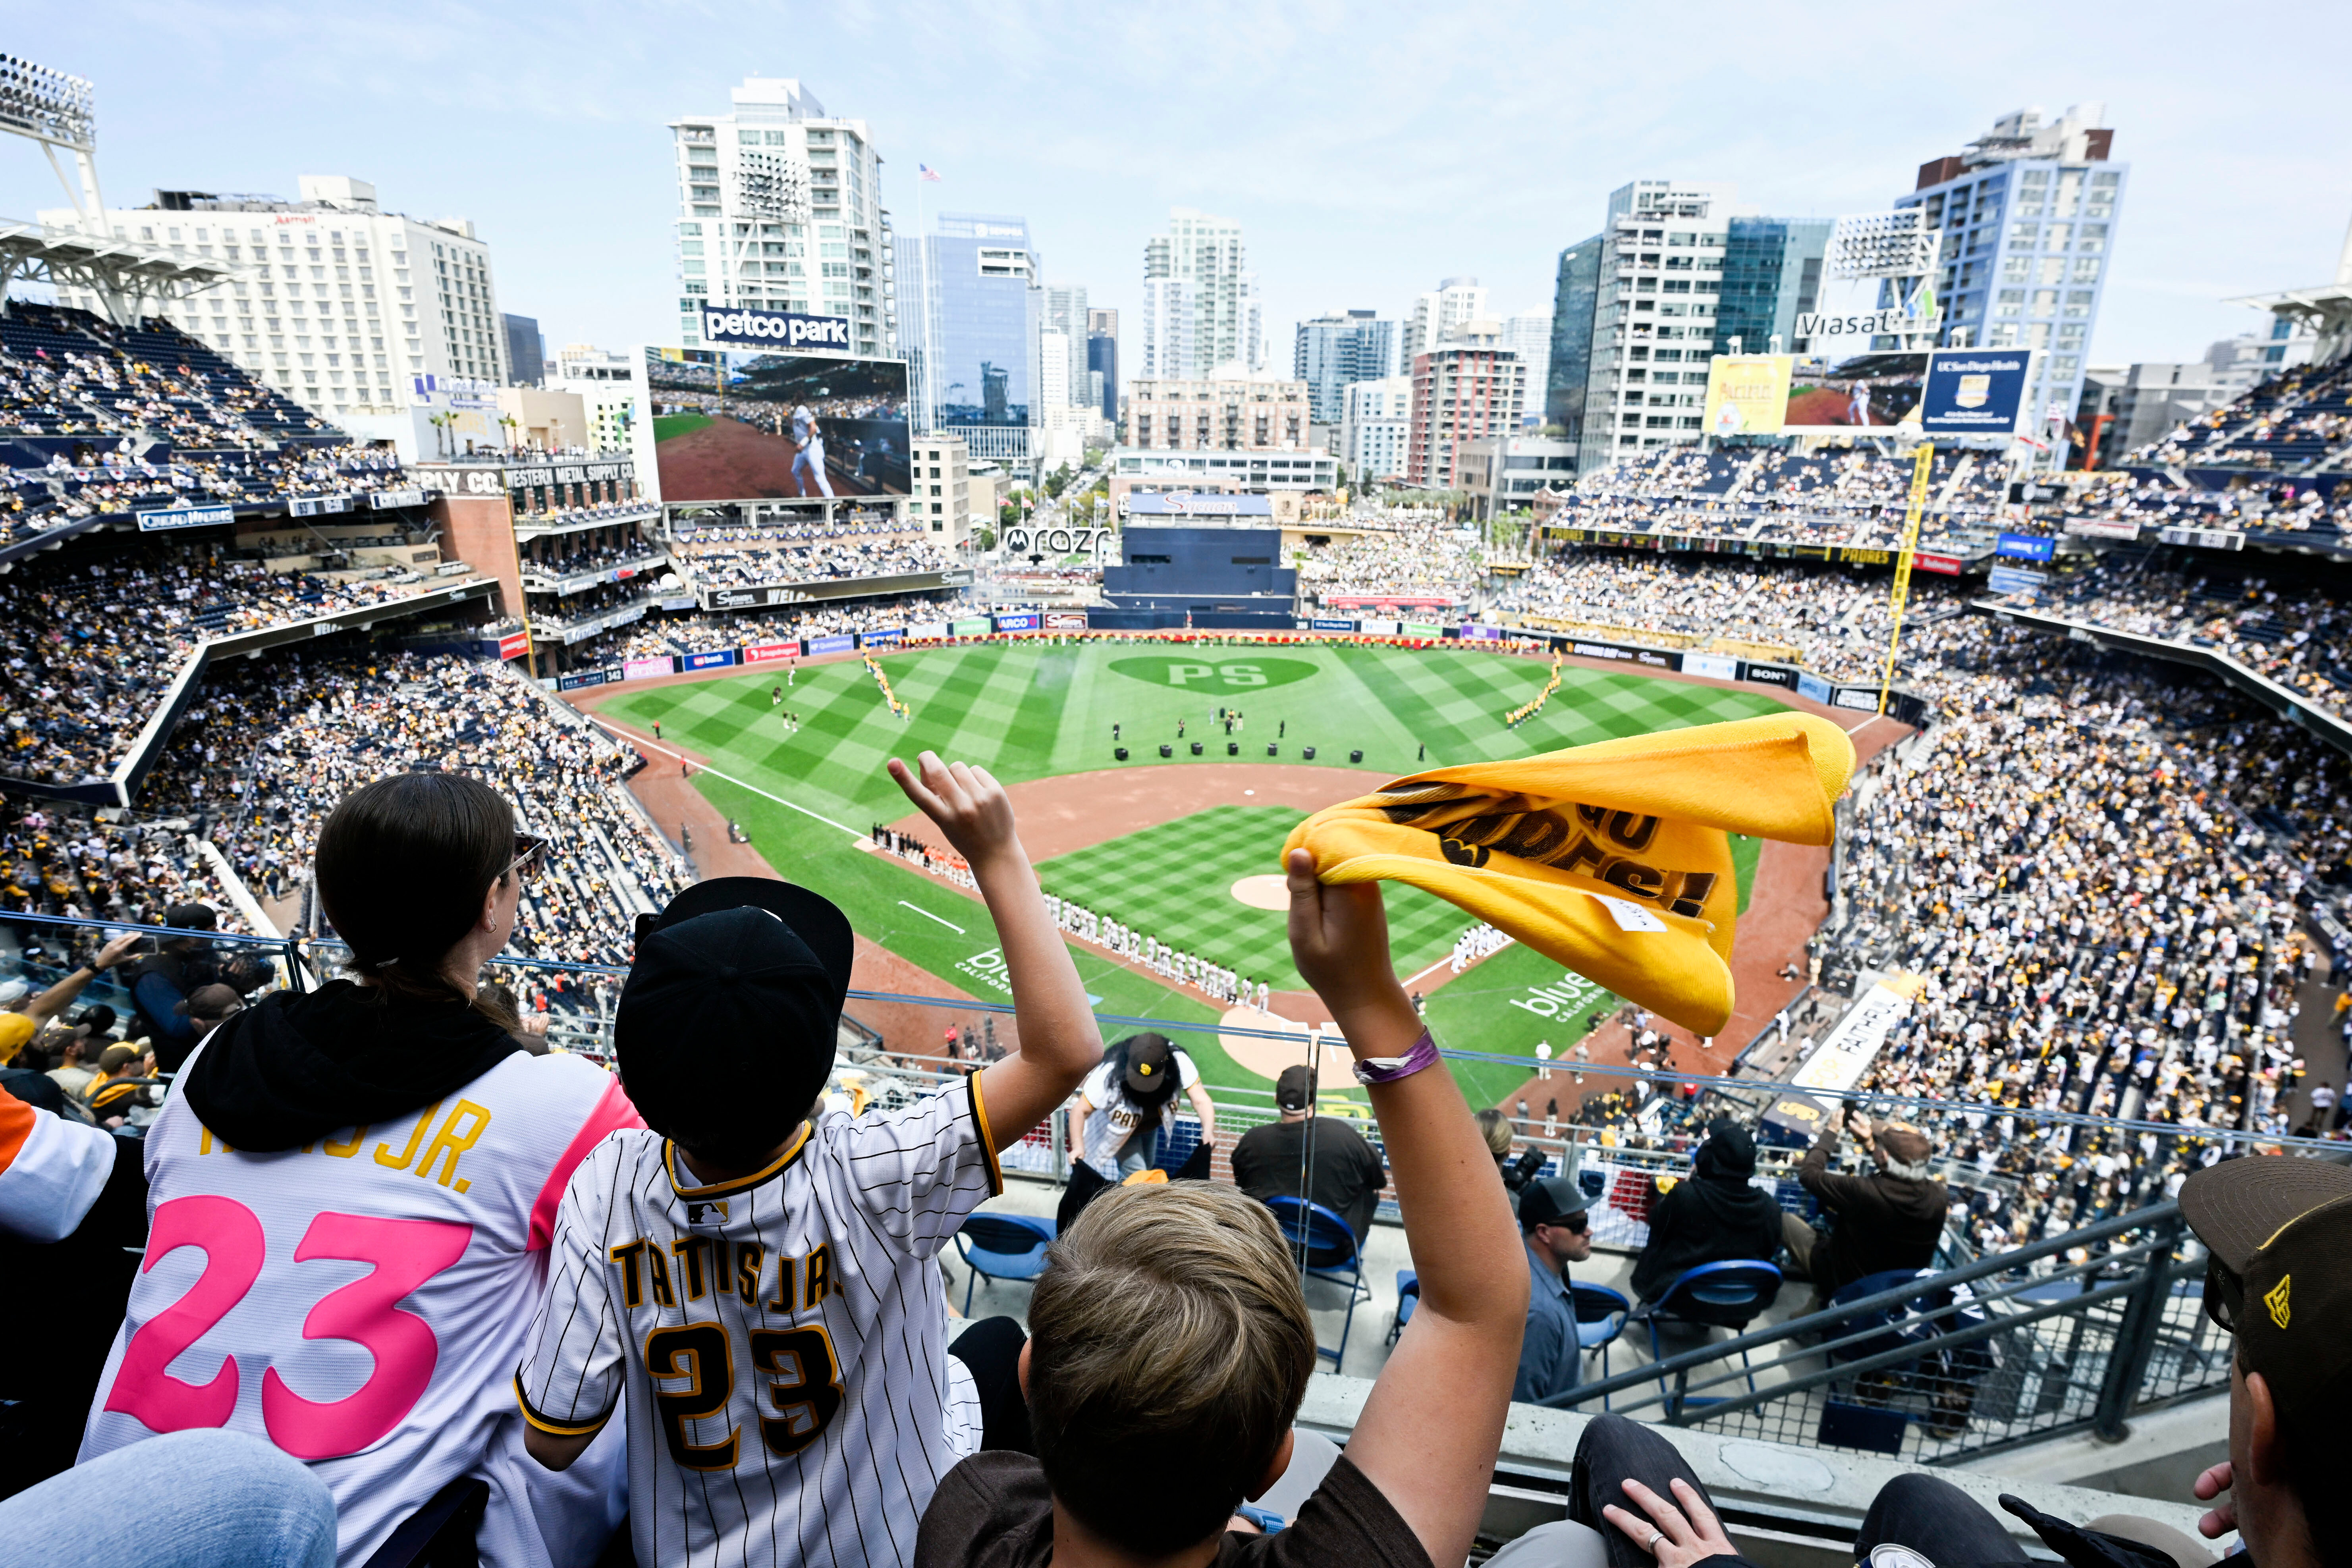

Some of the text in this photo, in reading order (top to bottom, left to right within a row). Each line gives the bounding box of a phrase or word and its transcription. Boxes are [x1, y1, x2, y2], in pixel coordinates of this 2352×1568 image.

[706, 310, 848, 346] petco park
[1803, 312, 1890, 335] Viasat
[467, 472, 505, 494] CO.
[504, 463, 635, 488] WESTERN METAL SUPPLY CO.
[1162, 490, 1240, 519] Sycuan
[1035, 530, 1109, 553] razr
[1840, 548, 1889, 564] PADRES
[1000, 617, 1028, 629] ARCO
[760, 647, 798, 658] Snapdragon
[607, 670, 622, 682] 342
[1752, 668, 1786, 681] SONY
[1509, 972, 1596, 1017] blue
[373, 1098, 492, 1194] JR.
[610, 1234, 845, 1314] TATIS JR.
[103, 1194, 474, 1460] 23
[644, 1321, 844, 1472] 23
